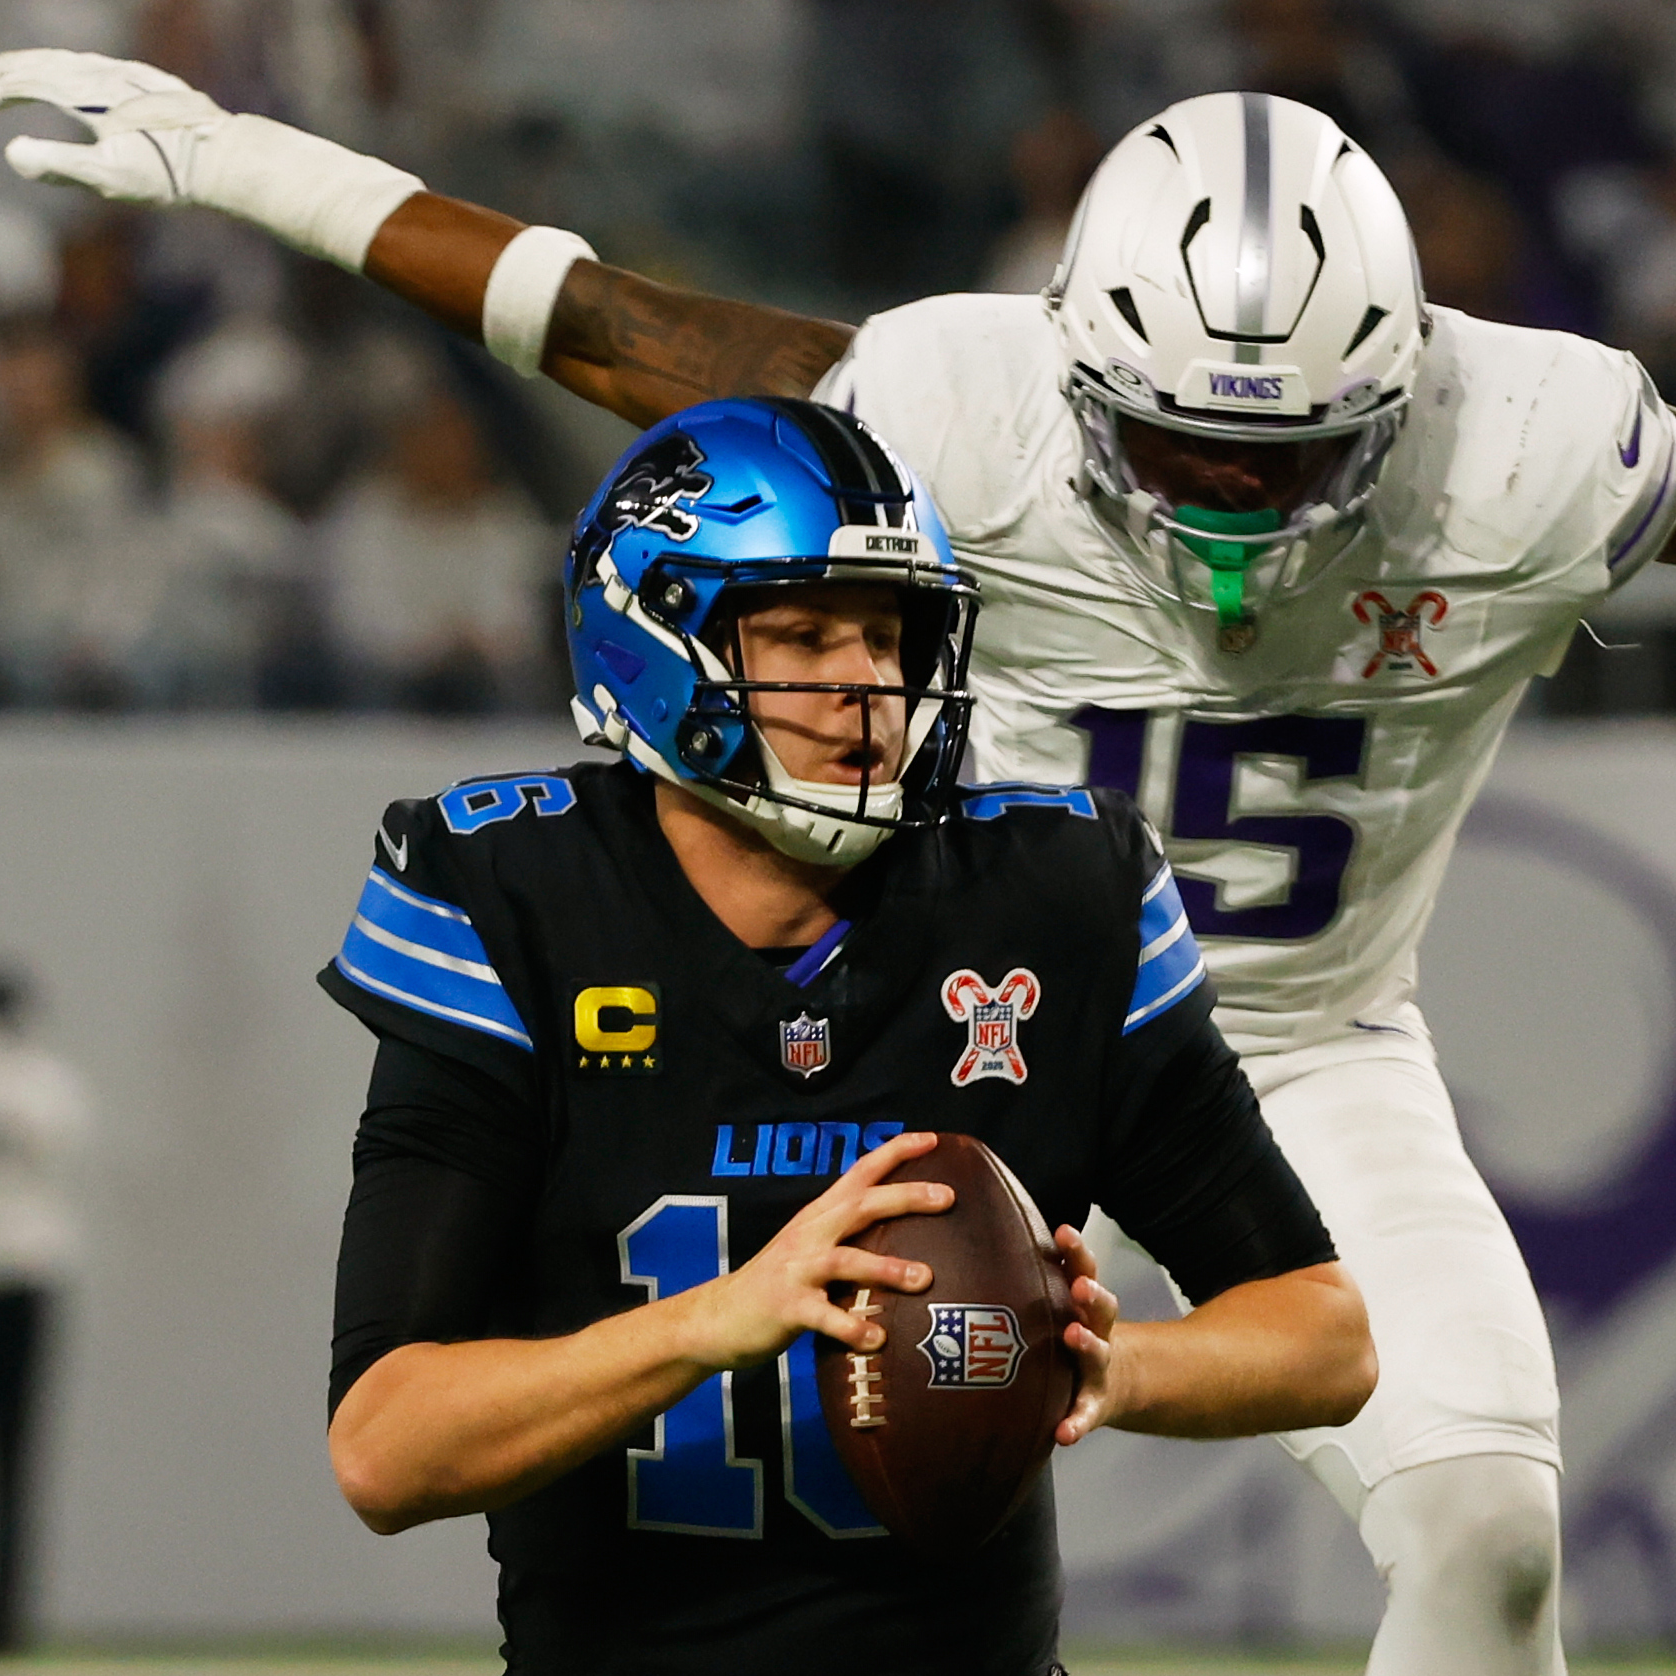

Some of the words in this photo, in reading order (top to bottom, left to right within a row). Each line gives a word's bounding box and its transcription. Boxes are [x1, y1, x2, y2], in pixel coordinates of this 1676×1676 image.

[1208, 372, 1283, 400] VIKINGS
[865, 534, 919, 554] DETROIT
[437, 766, 577, 835] 6
[574, 986, 657, 1053] C
[977, 1022, 1010, 1049] NFL
[788, 1043, 824, 1066] NFL
[968, 1314, 1014, 1380] NFL
